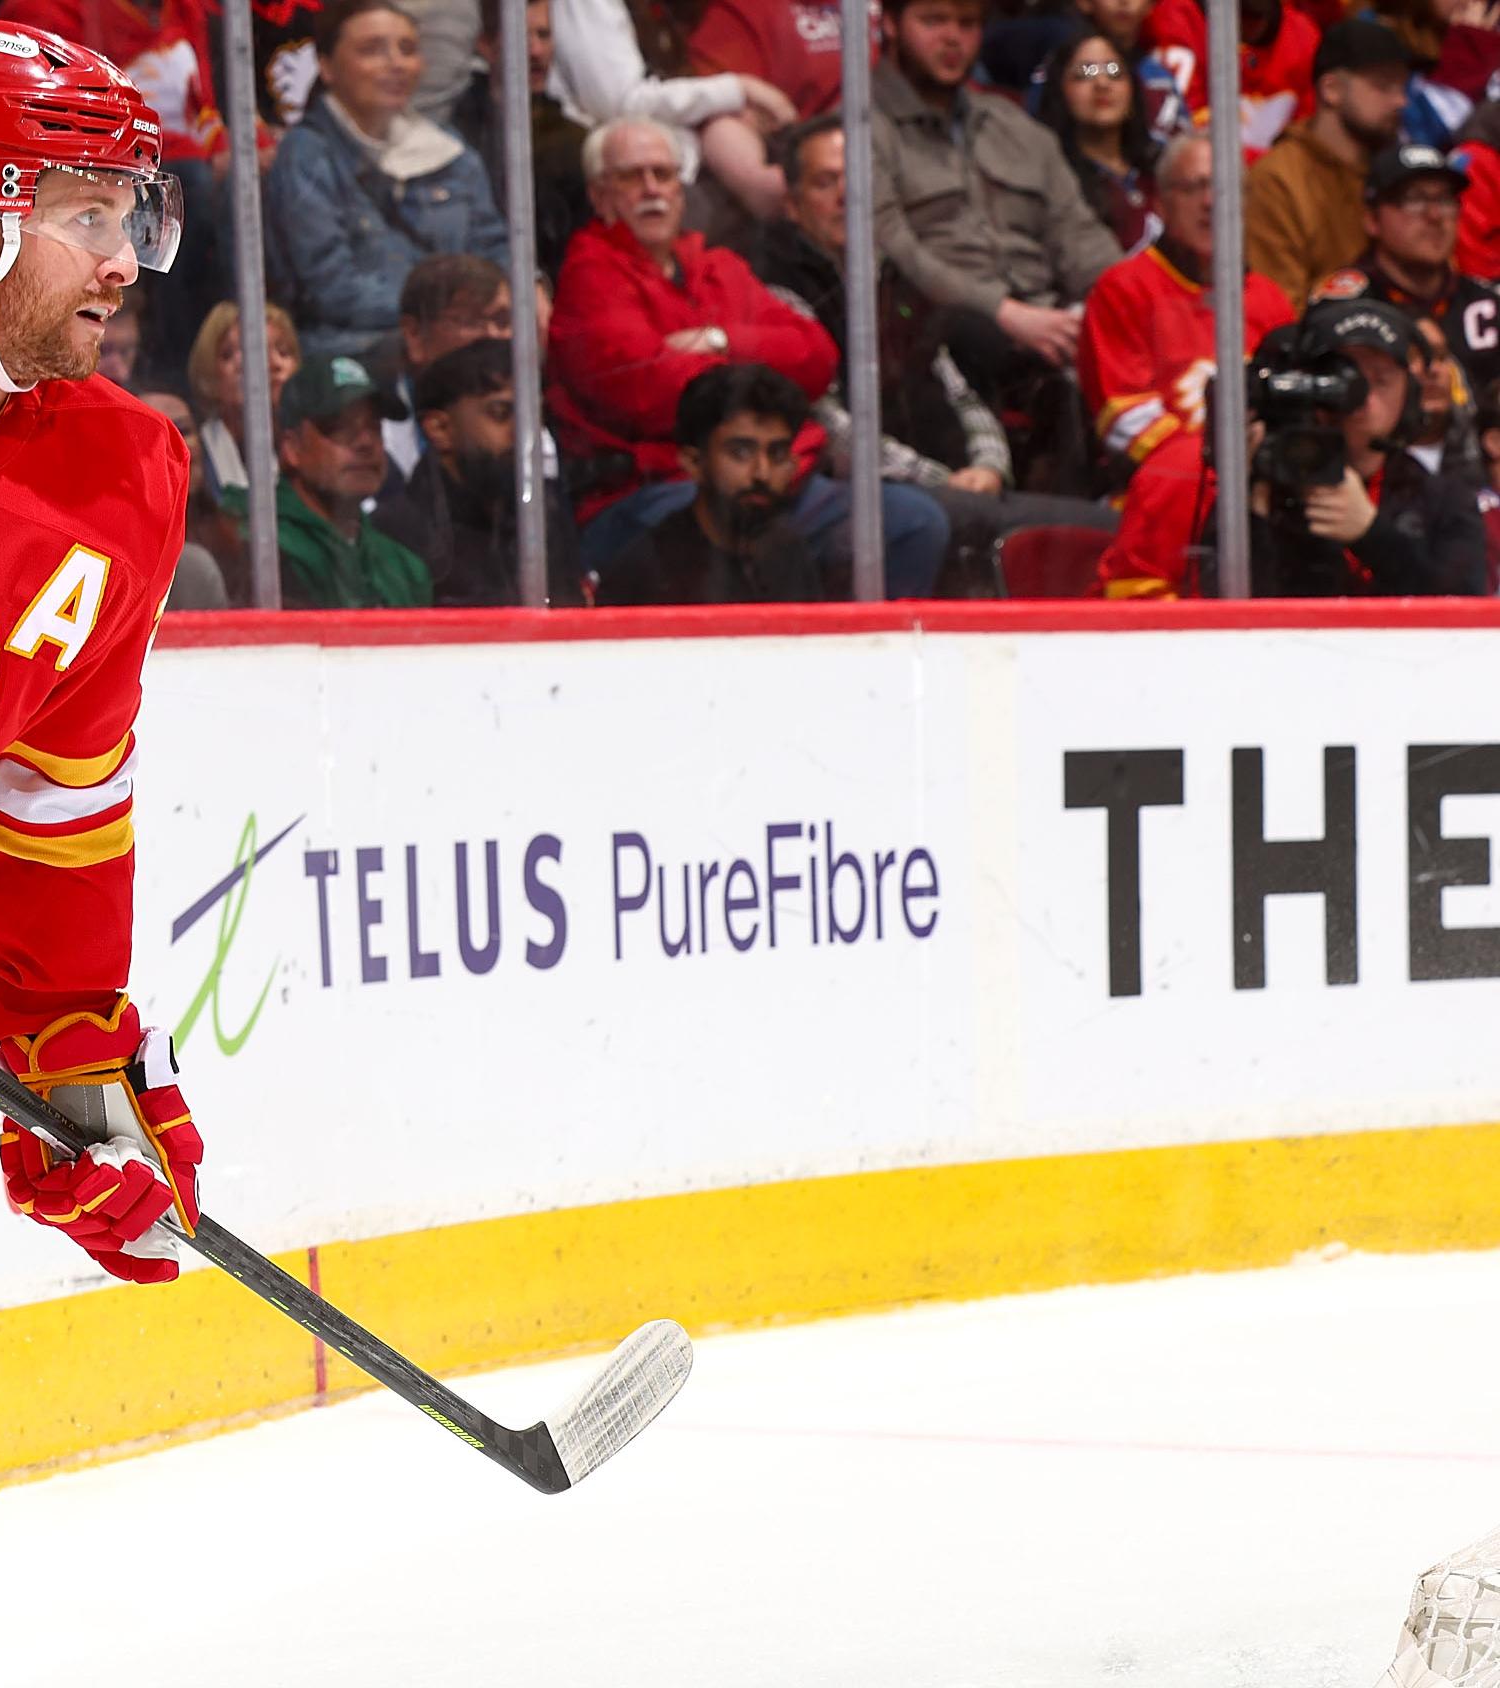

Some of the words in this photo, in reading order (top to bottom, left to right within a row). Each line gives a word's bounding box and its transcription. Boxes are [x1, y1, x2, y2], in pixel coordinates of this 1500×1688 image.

[132, 117, 160, 136] BAUE
[1463, 299, 1498, 350] C
[3, 542, 112, 672] A
[1063, 743, 1500, 997] THE
[304, 833, 568, 988] TELUS
[612, 820, 940, 961] PureFibre
[39, 1103, 76, 1131] ALPHA
[417, 1403, 485, 1449] WARRIOR
